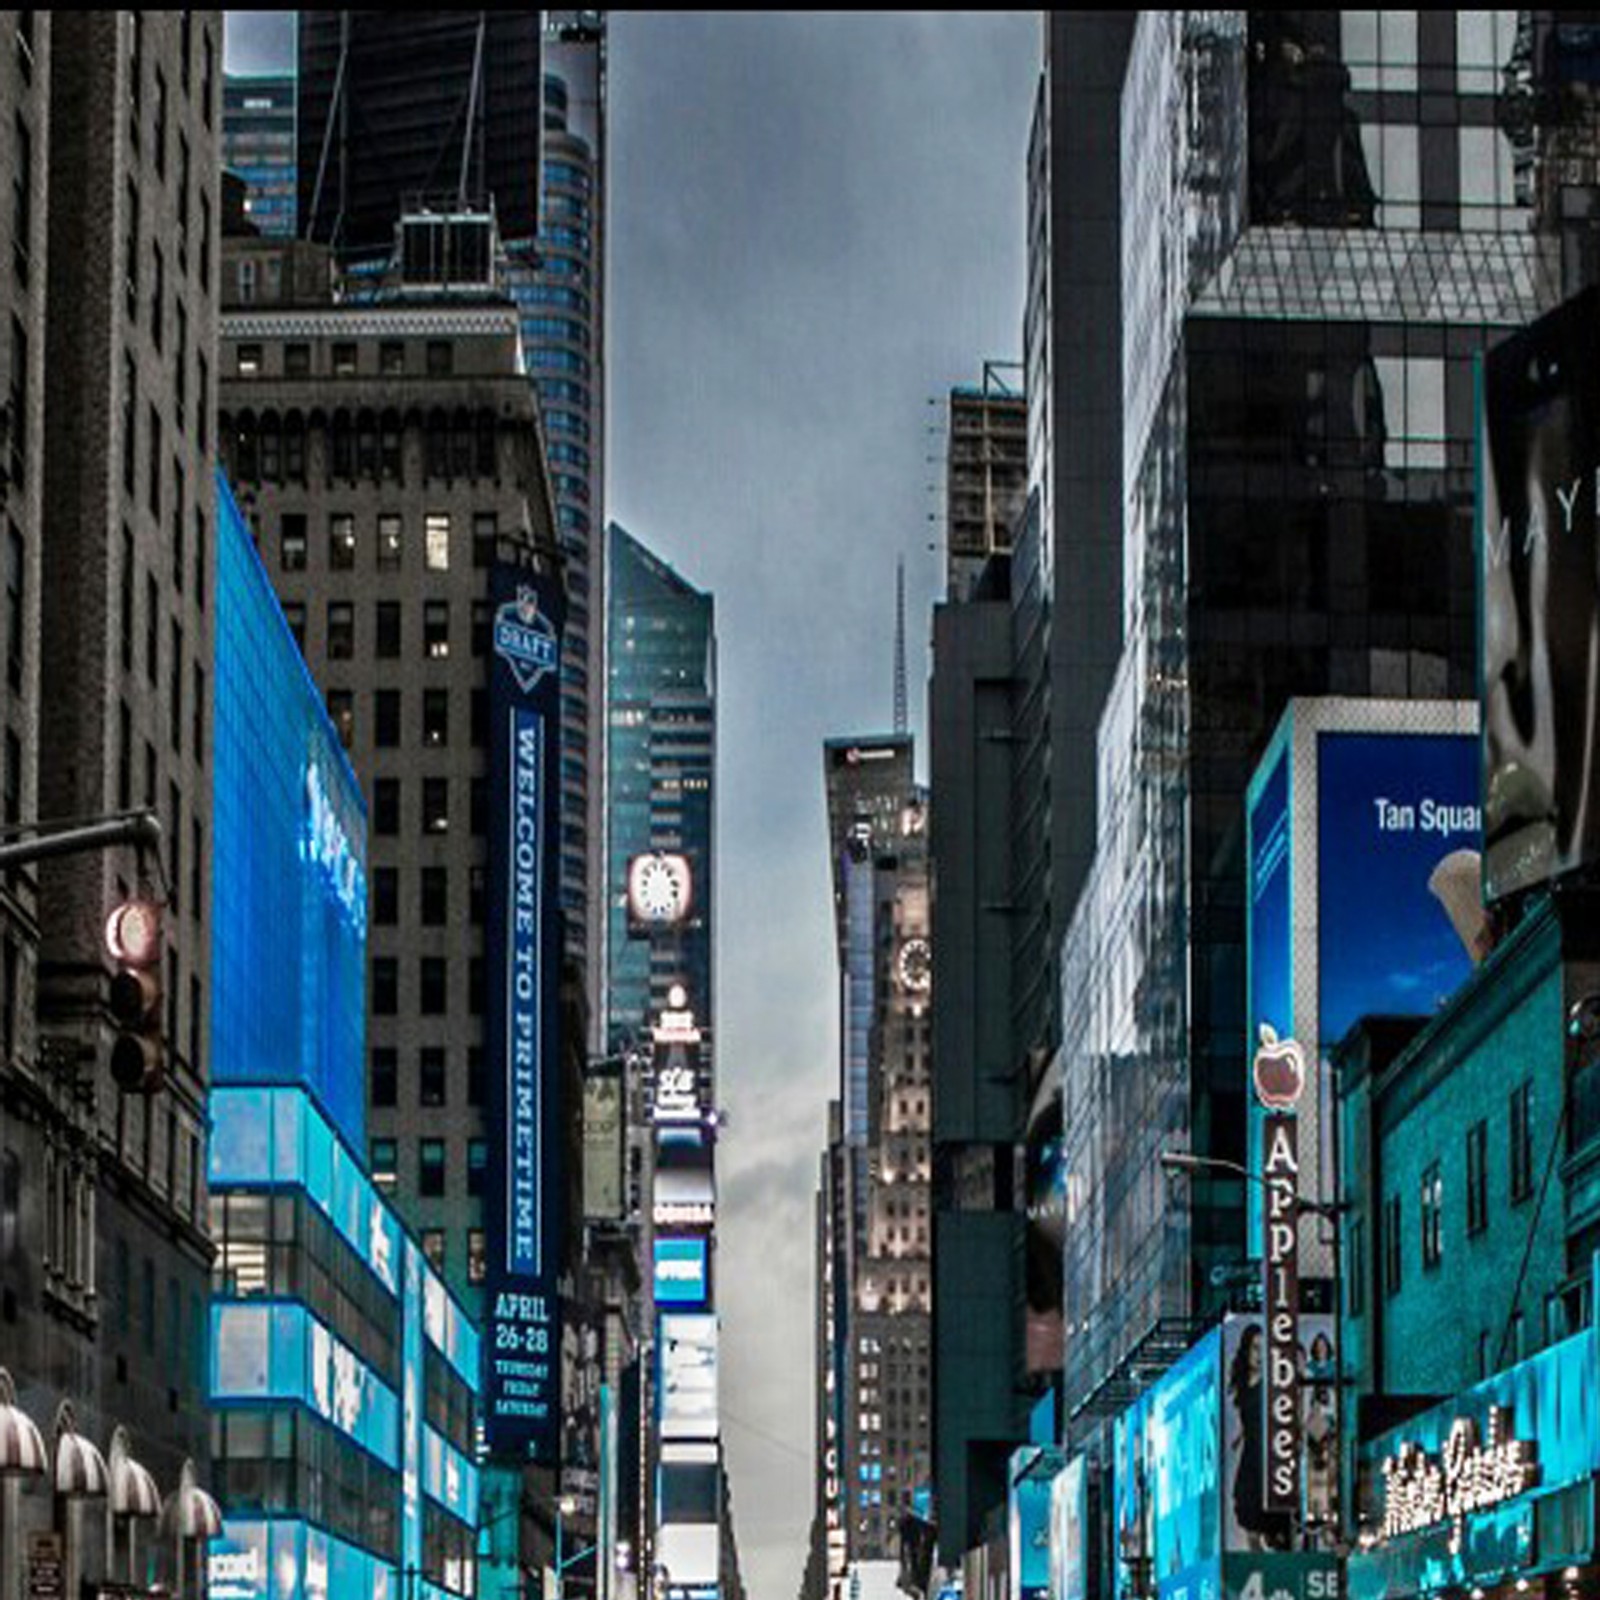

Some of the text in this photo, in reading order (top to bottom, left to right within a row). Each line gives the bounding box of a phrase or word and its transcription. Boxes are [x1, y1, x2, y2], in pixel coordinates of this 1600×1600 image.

[499, 625, 552, 660] DRAFT
[1374, 798, 1415, 830] Tan
[515, 727, 535, 1260] WELCOME TO PRIMETIME
[495, 1293, 549, 1322] APRIL
[1265, 1126, 1298, 1495] Applebee's
